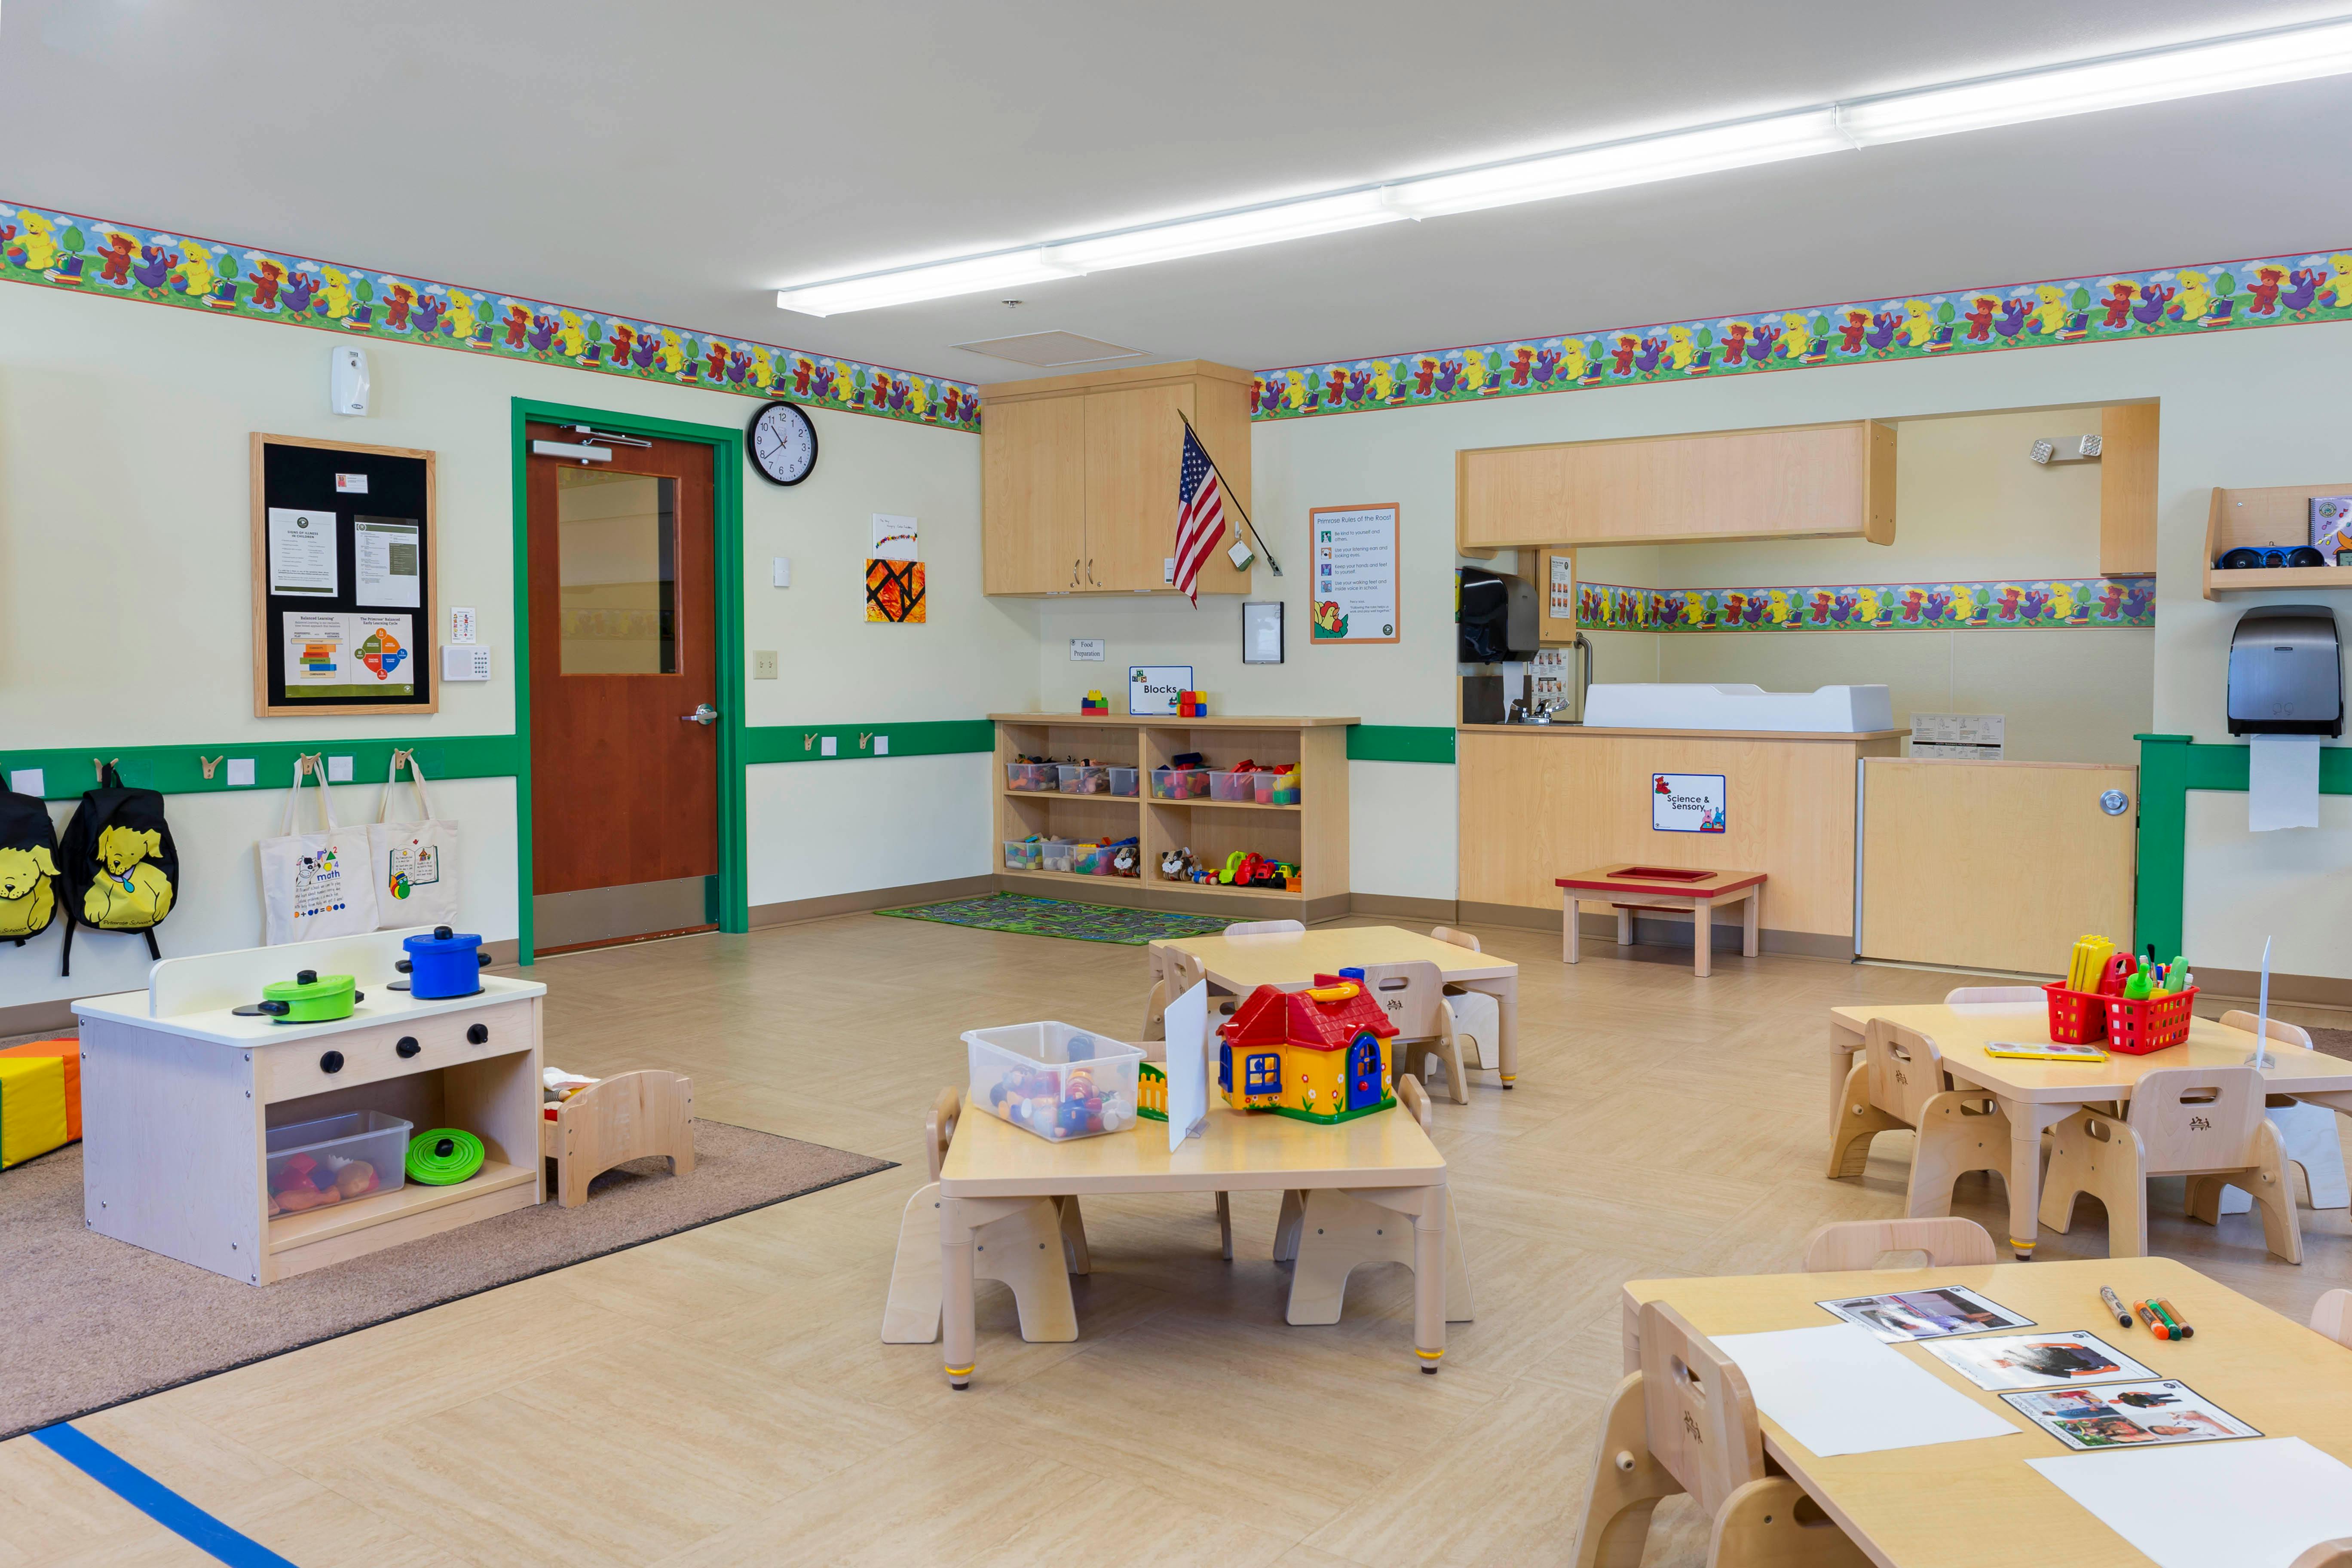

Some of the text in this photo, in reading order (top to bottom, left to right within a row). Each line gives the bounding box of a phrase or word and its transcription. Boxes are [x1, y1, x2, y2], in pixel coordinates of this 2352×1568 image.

[768, 416, 775, 424] 11
[778, 413, 786, 422] 12
[760, 423, 768, 432] 10
[791, 419, 794, 427] 1
[798, 429, 803, 438] 2
[757, 436, 762, 444] 9
[802, 443, 806, 452] 3
[760, 450, 765, 458] 8
[769, 461, 773, 469] 7
[790, 464, 794, 472] 5
[779, 466, 784, 475] 6
[1144, 685, 1177, 694] Blocks
[1667, 795, 1701, 803] Science
[1672, 802, 1705, 812] Sensory
[317, 870, 340, 881] math
